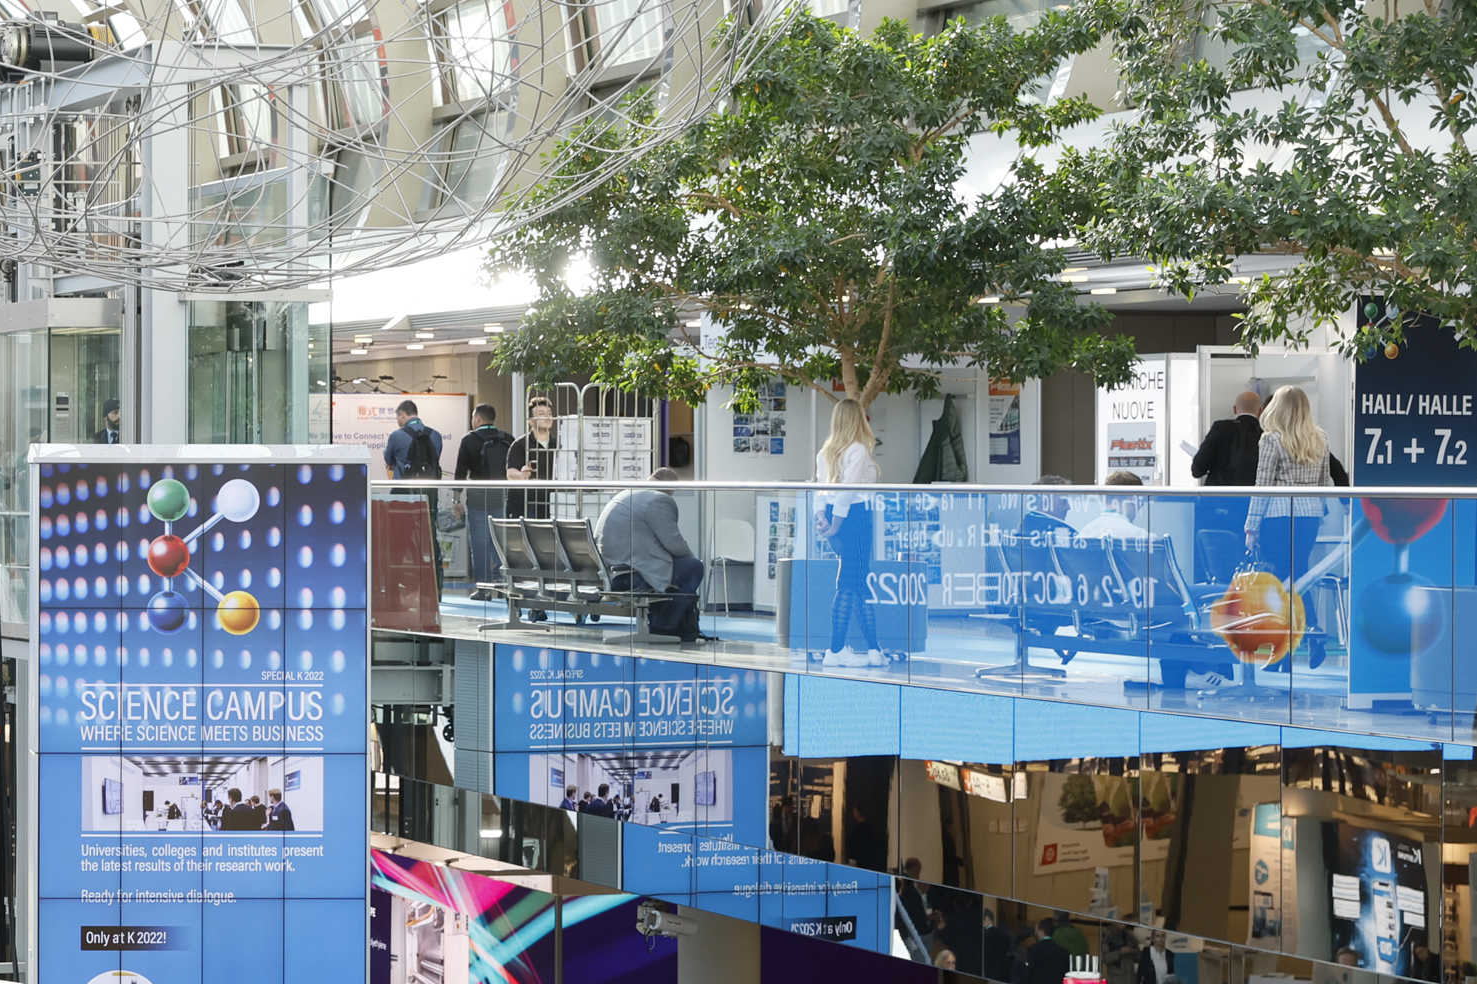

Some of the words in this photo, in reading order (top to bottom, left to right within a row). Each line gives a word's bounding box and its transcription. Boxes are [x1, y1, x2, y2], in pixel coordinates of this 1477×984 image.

[1112, 401, 1154, 419] NUOVE
[1362, 393, 1414, 415] HALL/
[1418, 394, 1472, 416] HALLE
[1364, 428, 1392, 464] 7.1
[1434, 428, 1467, 465] 7.2
[261, 671, 295, 681] SPECIAL
[297, 671, 303, 681] K
[304, 671, 324, 681] 2022
[80, 690, 197, 721] SCIENCE
[206, 690, 323, 722] CAMPUS
[80, 725, 133, 741] WHERE
[136, 725, 196, 741] SCIENCE
[200, 725, 248, 742] MEETS
[252, 725, 323, 742] BUSINESS
[81, 844, 148, 858] Universities,
[151, 844, 197, 859] colleges
[202, 844, 223, 857] and
[227, 844, 277, 857] institutes
[282, 845, 323, 859] present
[81, 859, 98, 872] the
[101, 859, 133, 872] latest
[134, 859, 172, 872] results
[174, 859, 185, 872] of
[186, 859, 213, 872] their
[215, 859, 262, 872] research
[264, 859, 295, 872] work.
[81, 889, 114, 906] Ready
[117, 889, 133, 903] for
[135, 889, 184, 903] intensive
[186, 889, 237, 906] dialogue.
[85, 931, 110, 947] Only
[112, 932, 125, 944] at
[127, 932, 135, 944] K
[137, 931, 167, 944] 2022!
